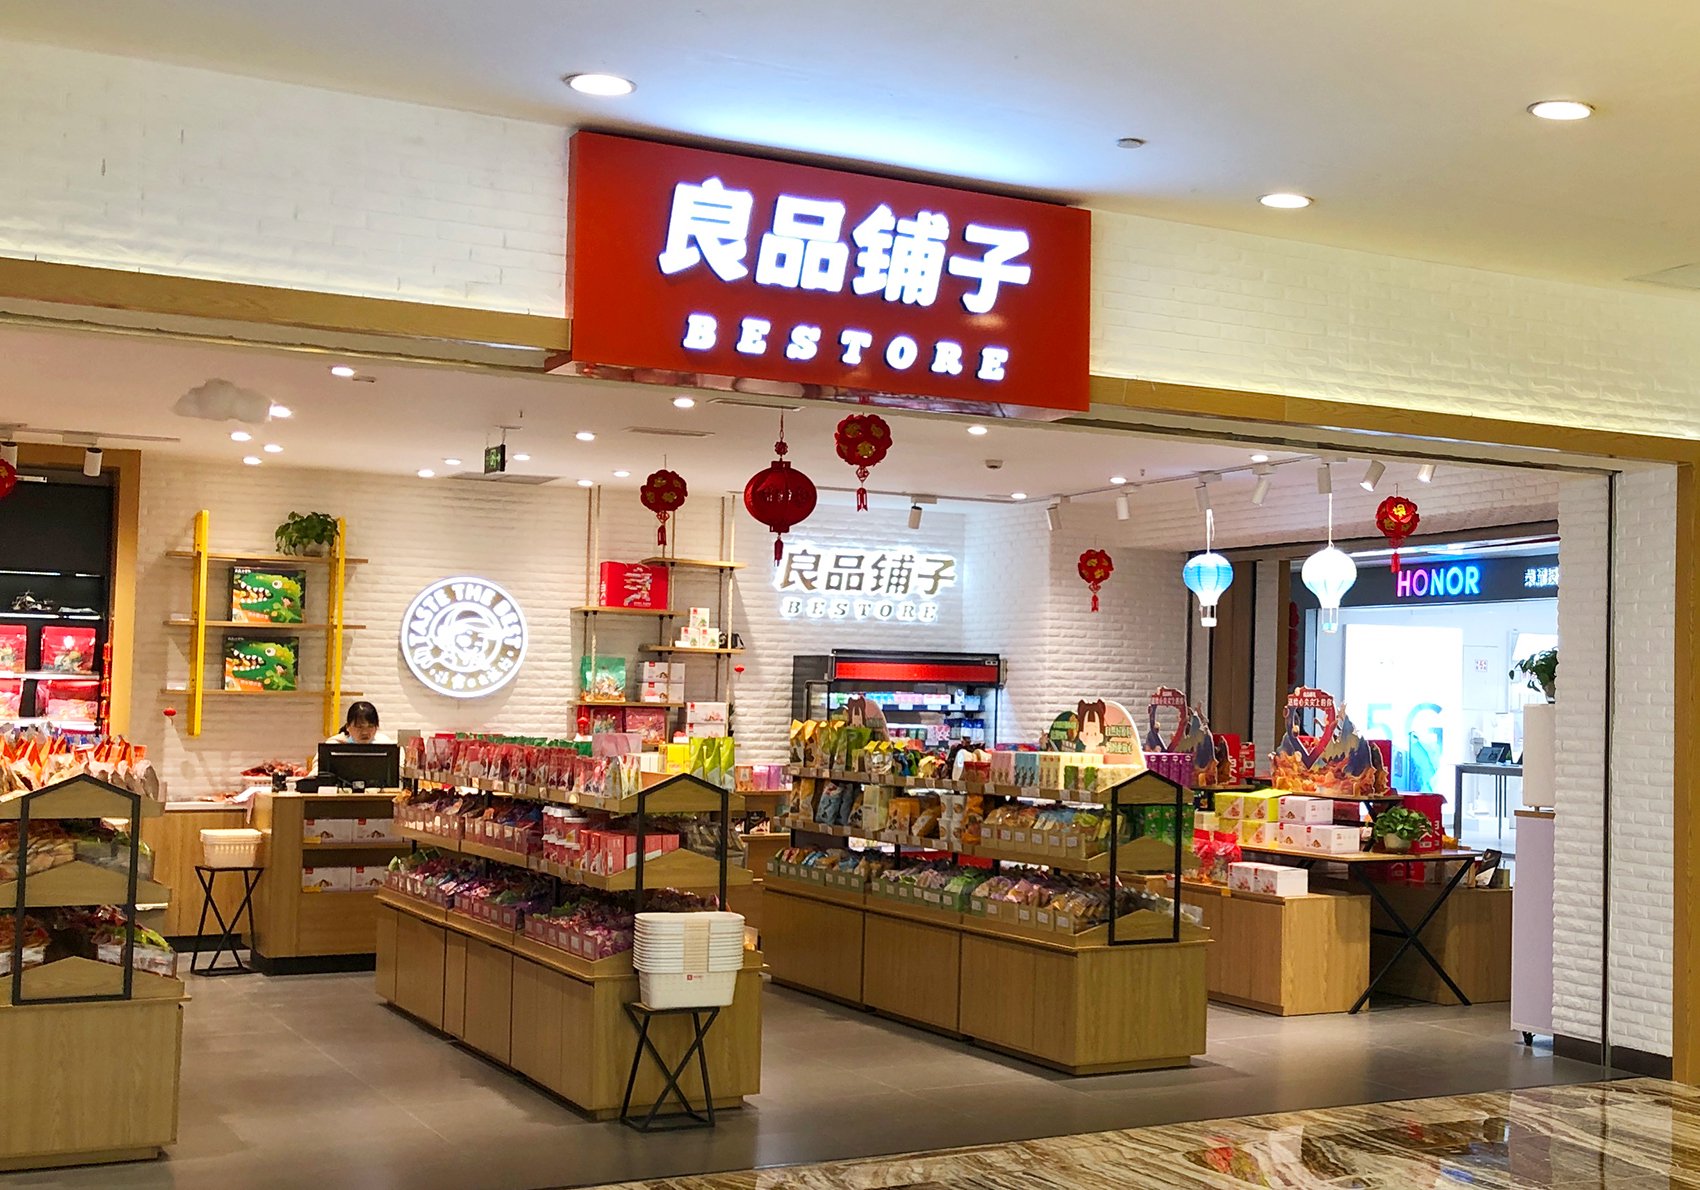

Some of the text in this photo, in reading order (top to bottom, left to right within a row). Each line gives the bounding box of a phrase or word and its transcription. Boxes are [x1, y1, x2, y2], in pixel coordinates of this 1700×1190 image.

[658, 177, 1032, 314] 良品铺子
[683, 313, 1009, 381] BESTORE
[780, 548, 956, 595] 良品铺子
[1396, 566, 1481, 598] HONOR
[409, 582, 522, 650] TASTE THE BEST
[786, 599, 938, 620] BESTORE
[1366, 702, 1444, 757] 5G
